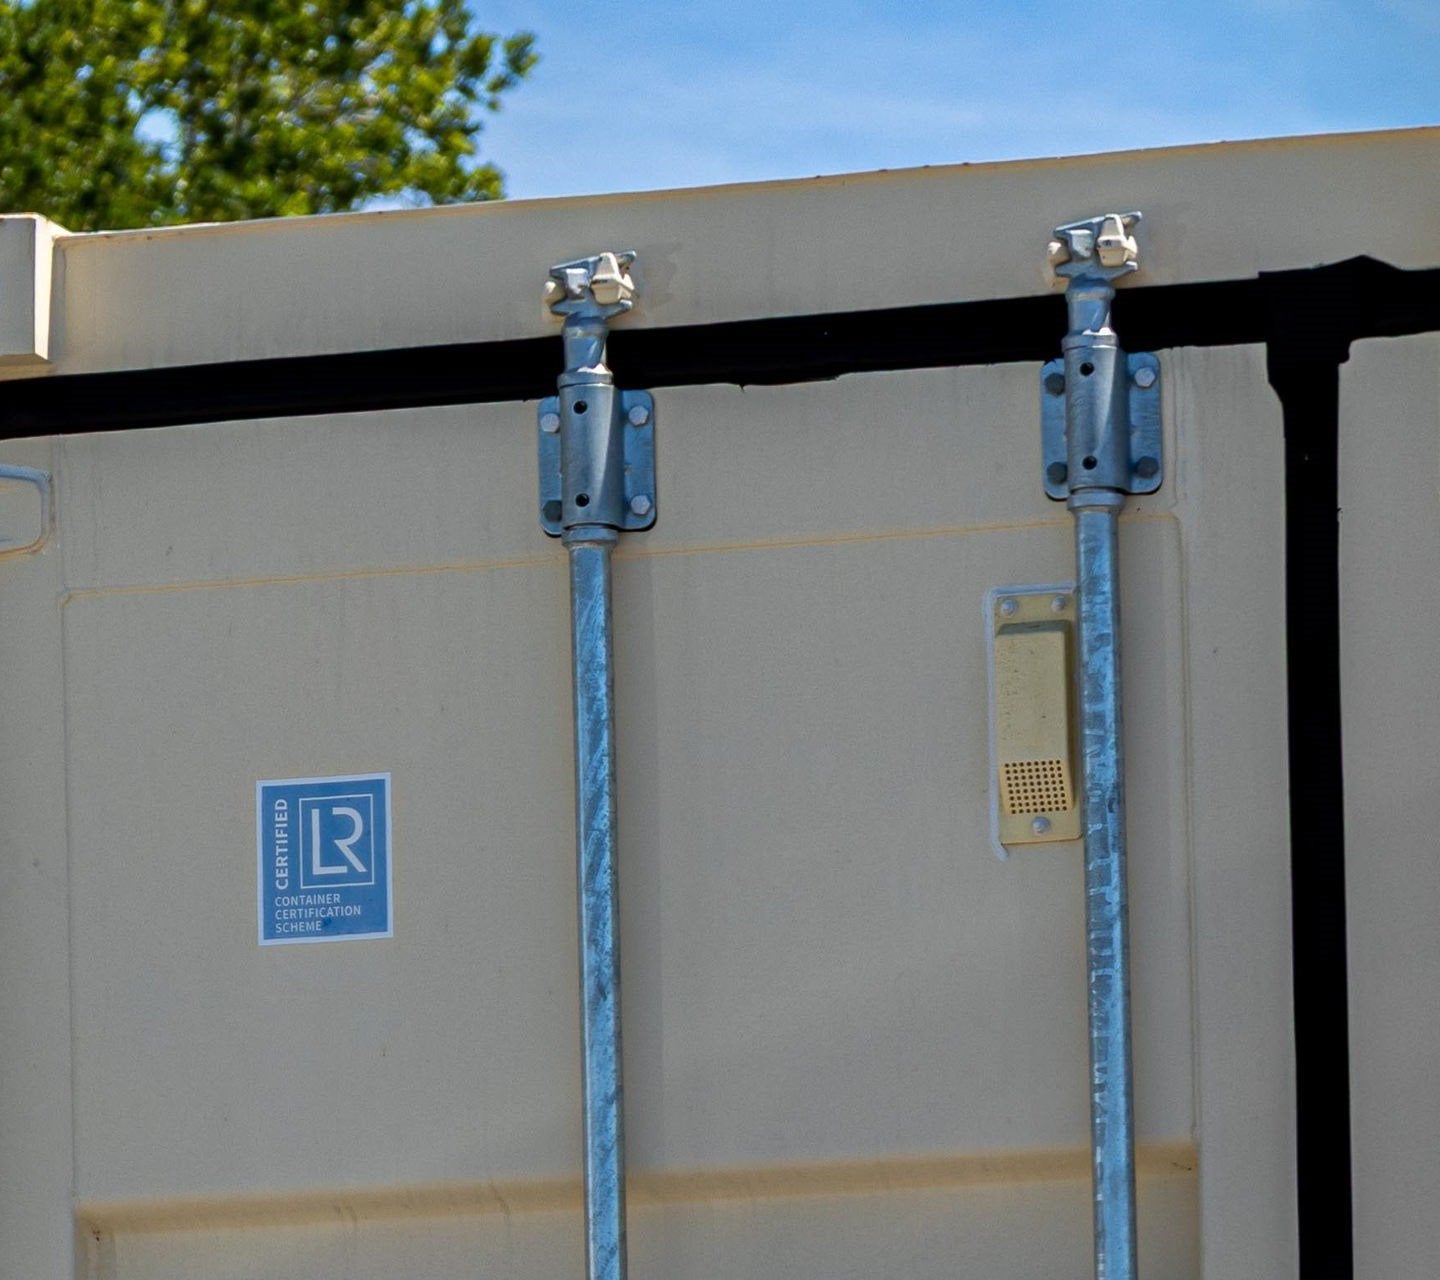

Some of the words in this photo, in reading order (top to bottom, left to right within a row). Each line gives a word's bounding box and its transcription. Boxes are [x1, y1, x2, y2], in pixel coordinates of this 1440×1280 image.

[274, 798, 289, 890] CERTIFIED
[310, 806, 368, 875] LR
[275, 893, 341, 907] CONTAINER
[275, 904, 362, 920] CERTIFICATION
[275, 920, 323, 934] SCHEME
